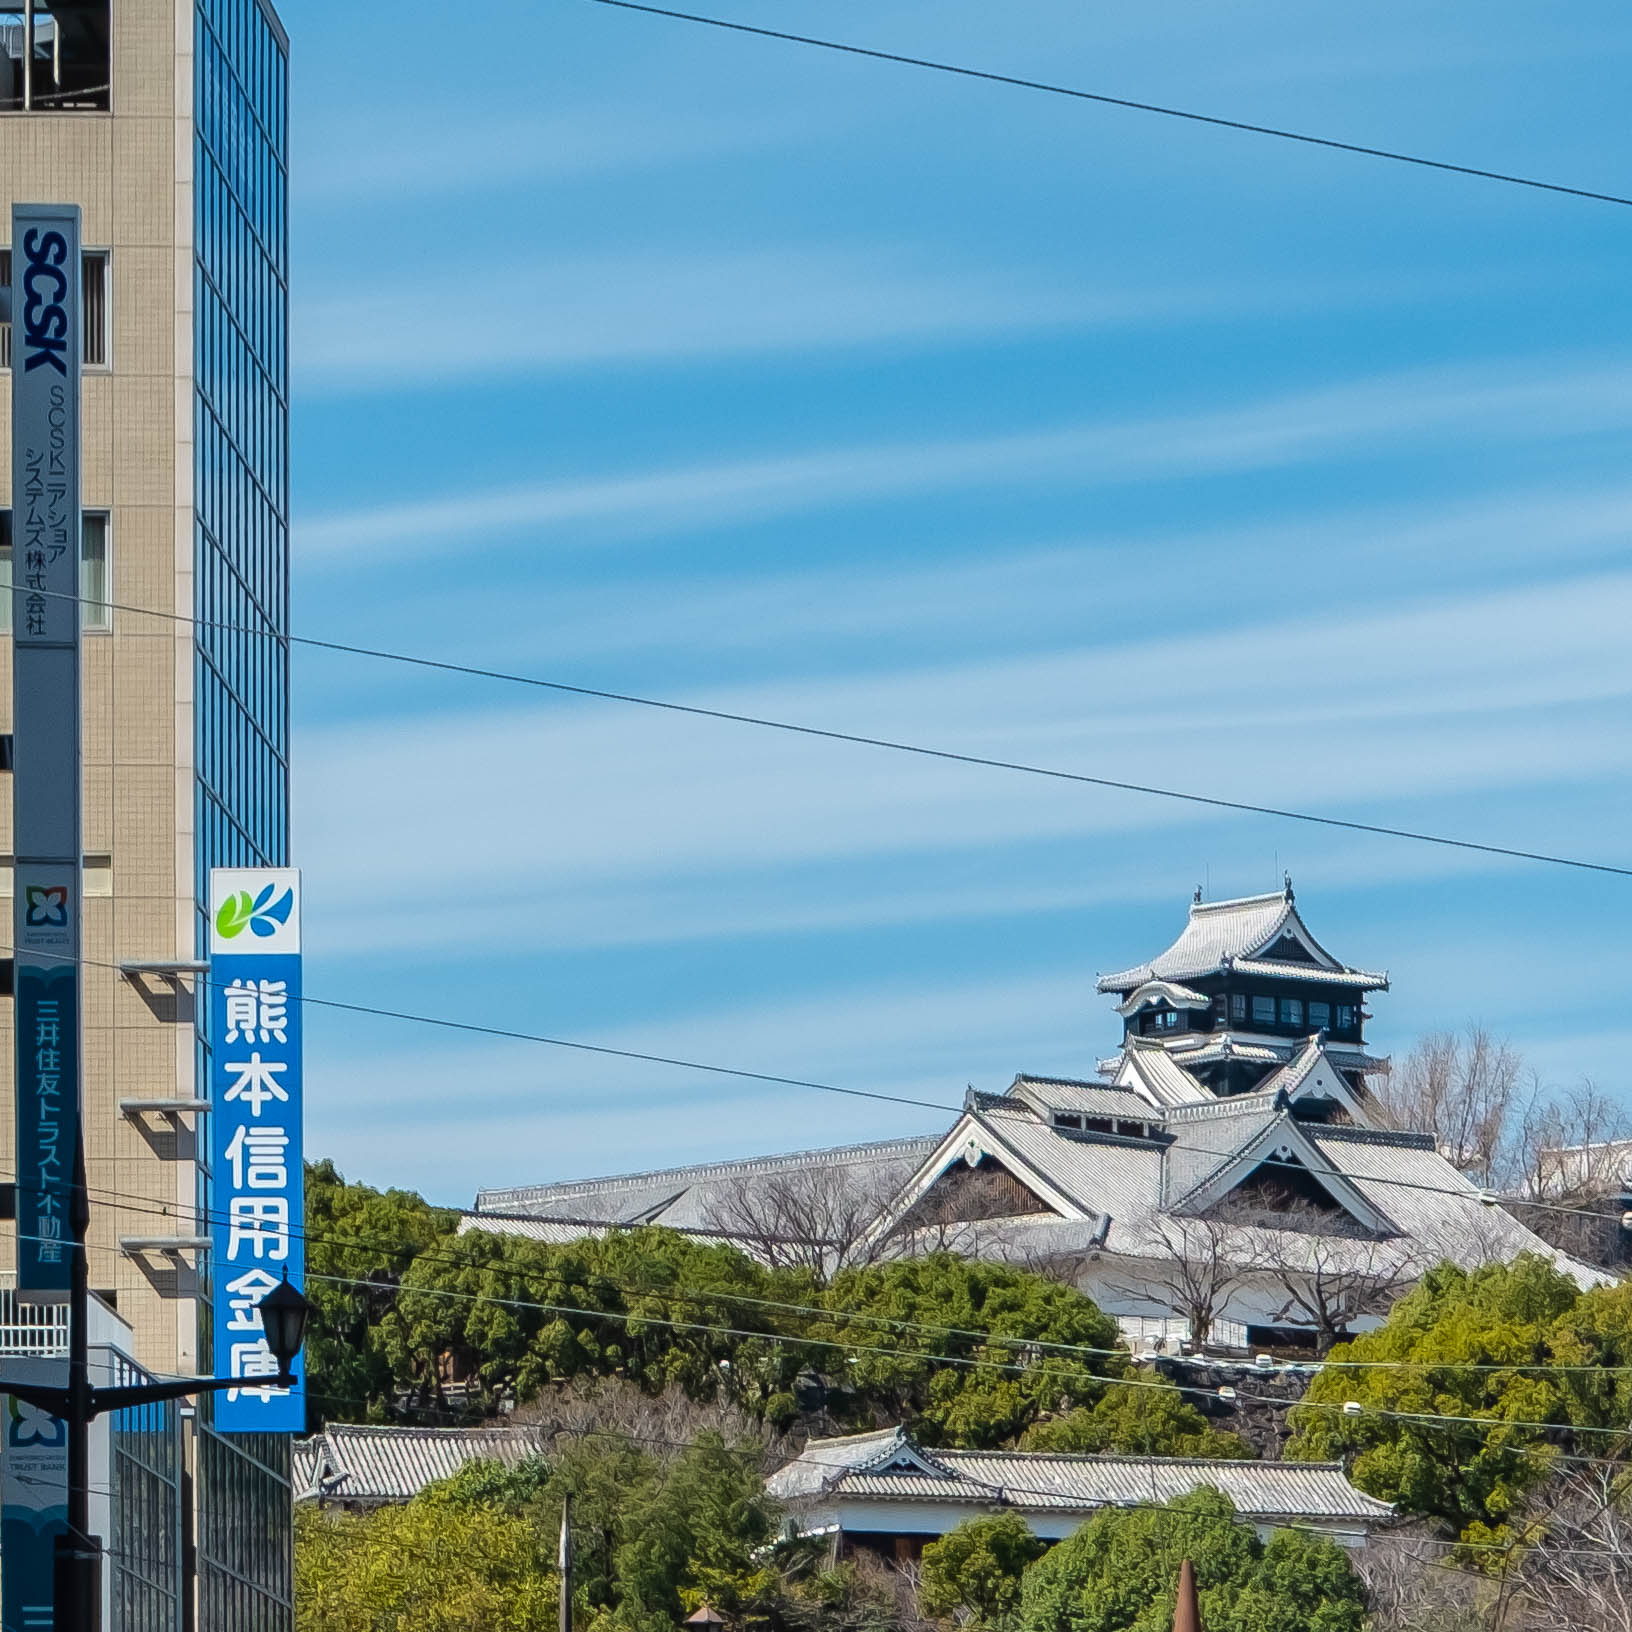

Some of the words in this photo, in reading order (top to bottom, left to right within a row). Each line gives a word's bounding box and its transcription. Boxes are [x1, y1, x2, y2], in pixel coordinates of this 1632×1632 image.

[23, 228, 68, 378] SCSK
[25, 447, 46, 636] システムズ株式会社
[47, 385, 67, 564] SCSKニアショア
[36, 1000, 62, 1265] 三井住友トラスト不動産
[223, 978, 290, 1403] 熊本信用金庫
